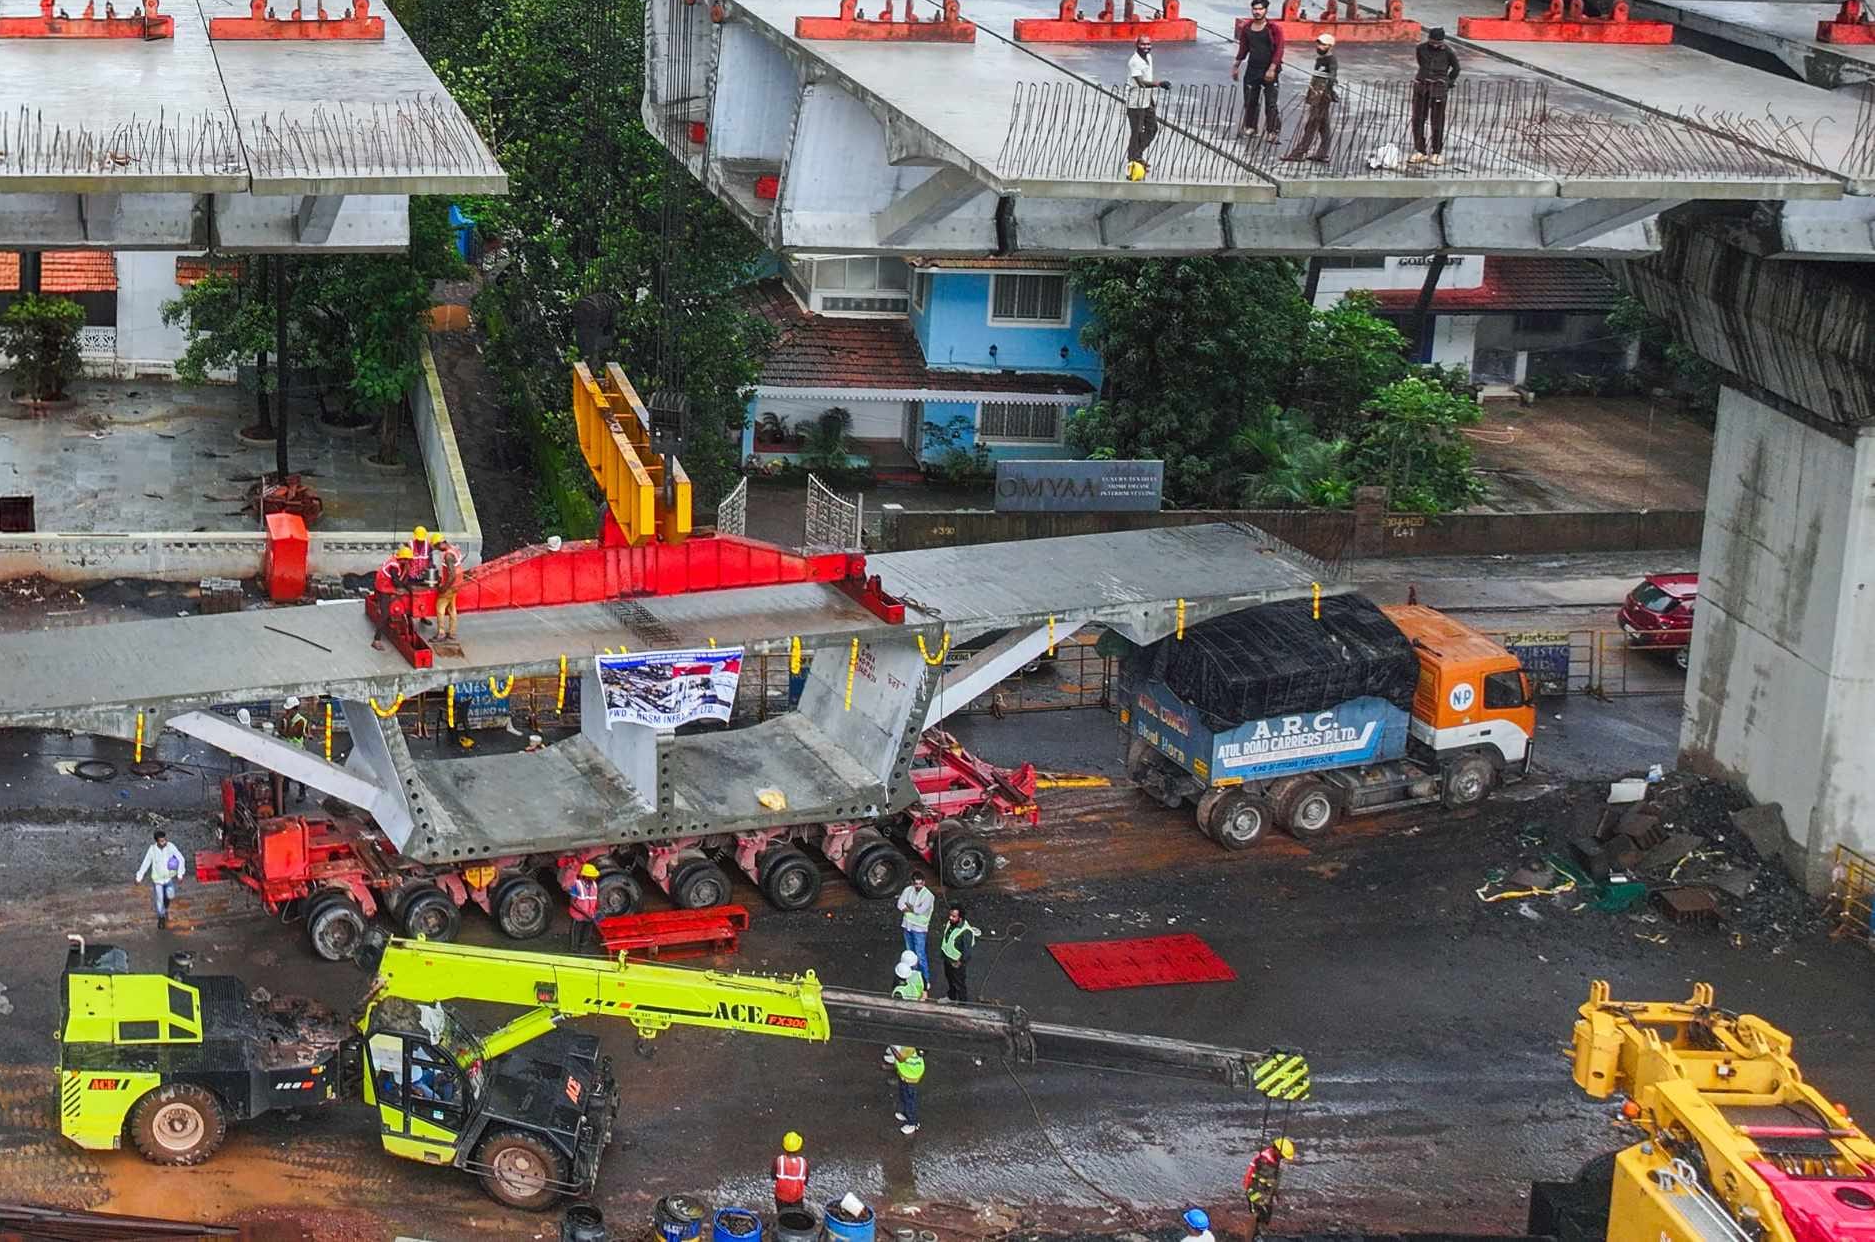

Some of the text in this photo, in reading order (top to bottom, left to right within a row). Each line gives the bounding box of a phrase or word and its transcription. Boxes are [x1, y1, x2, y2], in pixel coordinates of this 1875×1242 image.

[997, 476, 1098, 499] OMYAA
[1217, 739, 1242, 759] ATUL
[1243, 737, 1269, 756] ROAD
[1270, 730, 1322, 753] CARRIERS
[713, 1001, 807, 1029] ACE FX300
[90, 1078, 116, 1090] ACE
[565, 1075, 582, 1104] ACE
